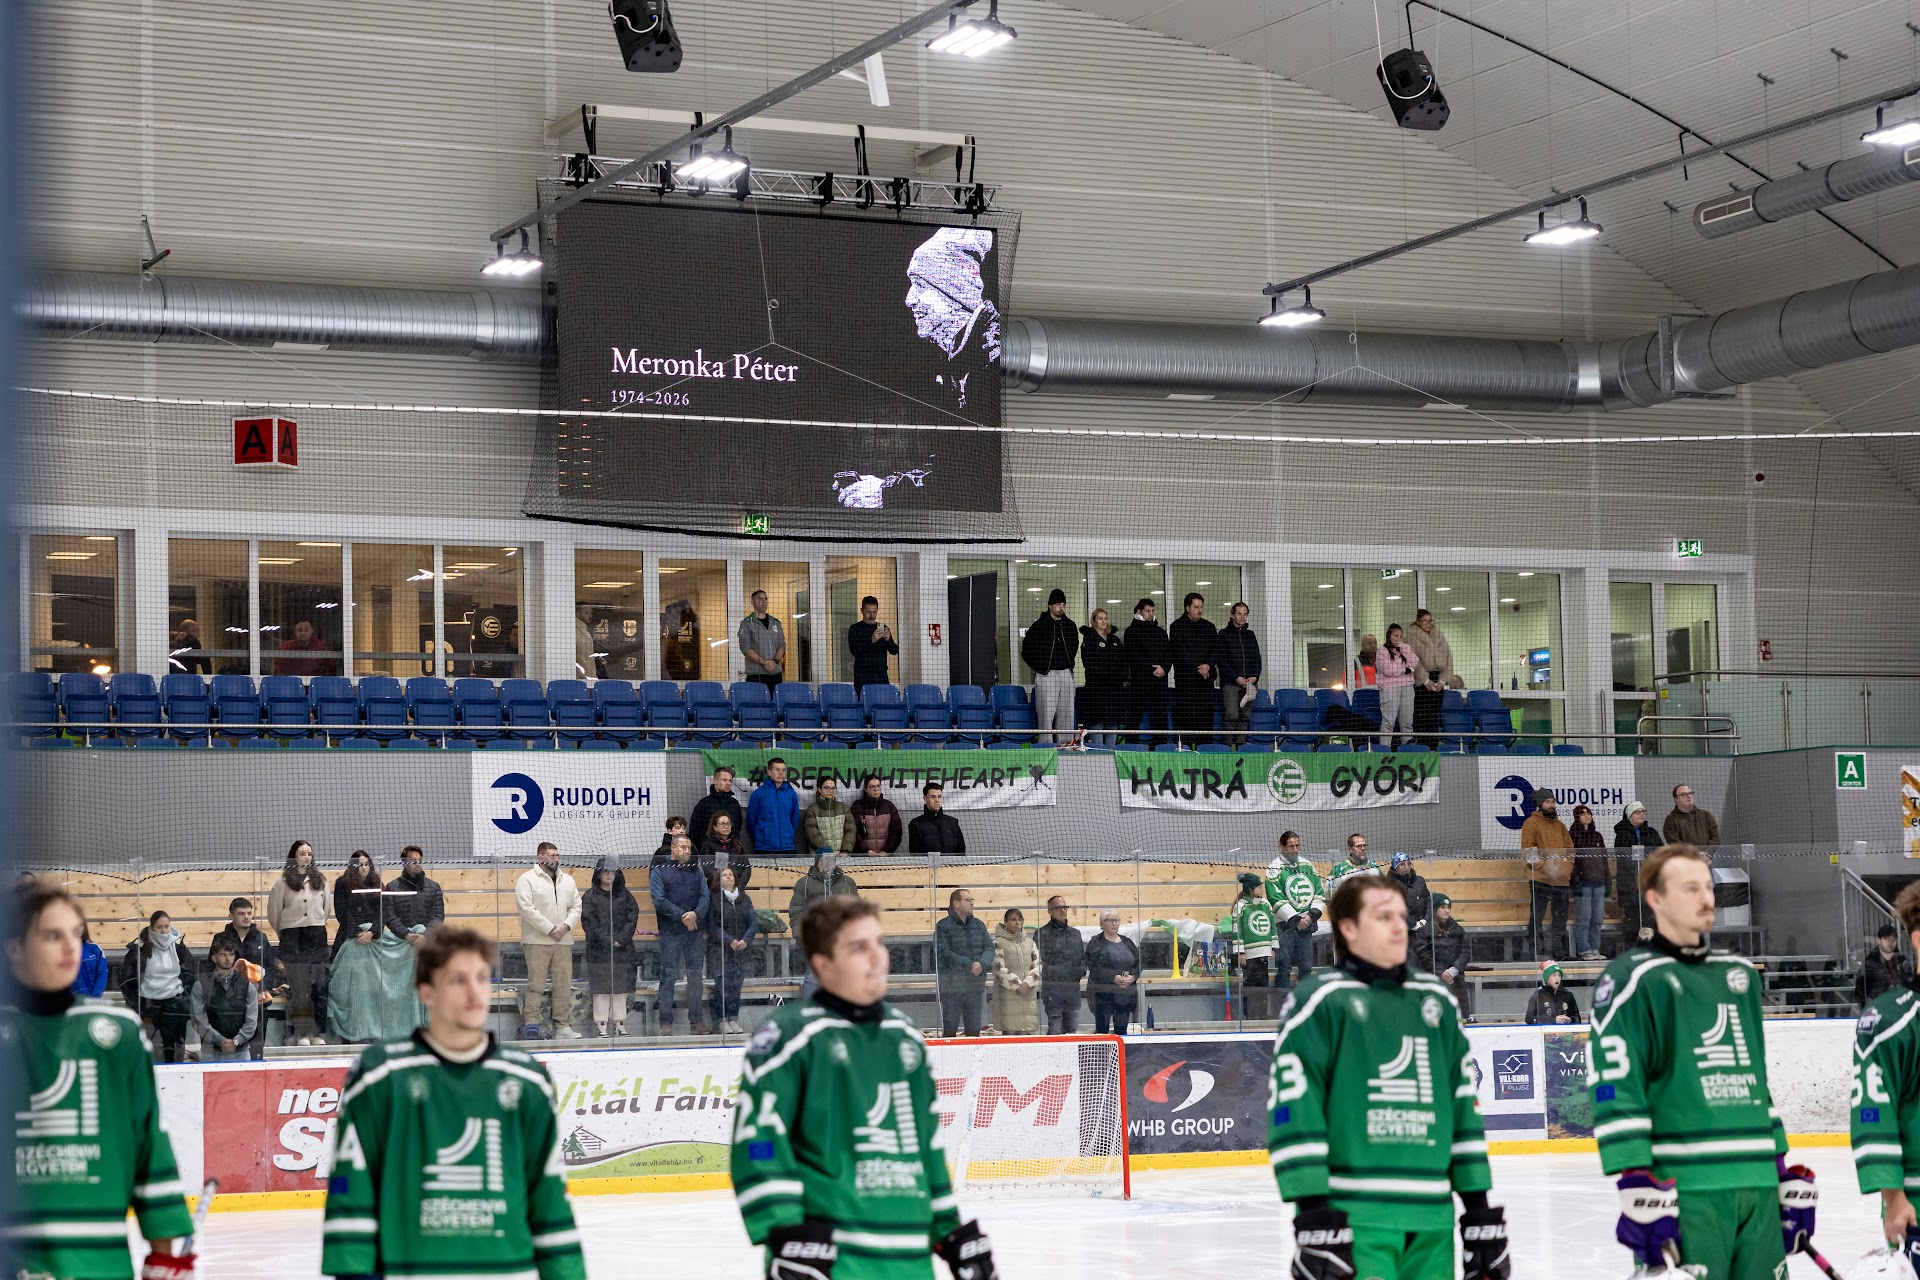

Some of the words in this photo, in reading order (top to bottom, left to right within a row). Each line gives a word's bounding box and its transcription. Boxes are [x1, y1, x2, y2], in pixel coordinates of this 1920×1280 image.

[611, 347, 726, 378] Meronka
[733, 353, 799, 382] Péter
[611, 389, 690, 406] 1974–2026
[241, 424, 267, 456] A
[281, 425, 295, 457] A
[748, 766, 1021, 791] #REENWHITEHEART
[1130, 757, 1249, 801] HAJRÁ
[1330, 756, 1426, 798] GYŐR!
[1844, 760, 1859, 779] A
[553, 787, 651, 806] RUDOLPH
[1546, 788, 1623, 805] UDOLPH
[1909, 797, 1920, 810] T
[553, 810, 604, 819] LOGISTIK
[609, 810, 651, 819] GRUPPE
[1559, 1051, 1585, 1064] Vi
[277, 1087, 345, 1115] ne
[553, 1077, 643, 1116] Vitál
[655, 1075, 741, 1112] Fahá
[735, 1089, 788, 1145] 24
[1127, 1119, 1166, 1137] WHB
[1170, 1118, 1235, 1136] GROUP
